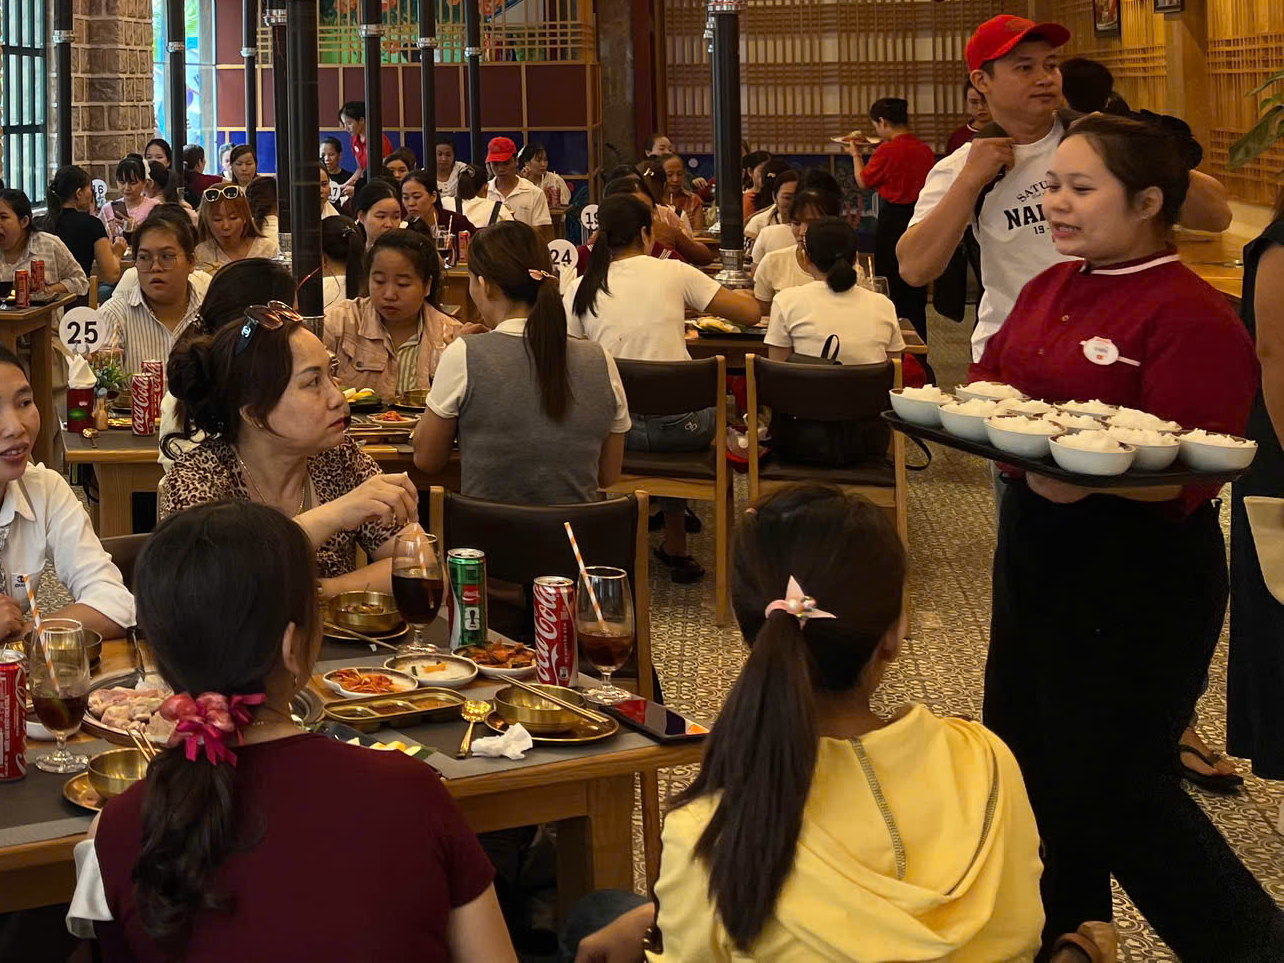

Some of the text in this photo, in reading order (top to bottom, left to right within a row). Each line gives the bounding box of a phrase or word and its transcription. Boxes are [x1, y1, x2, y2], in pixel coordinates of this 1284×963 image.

[1017, 180, 1049, 202] SATU
[550, 249, 572, 265] 24
[67, 321, 99, 345] 25
